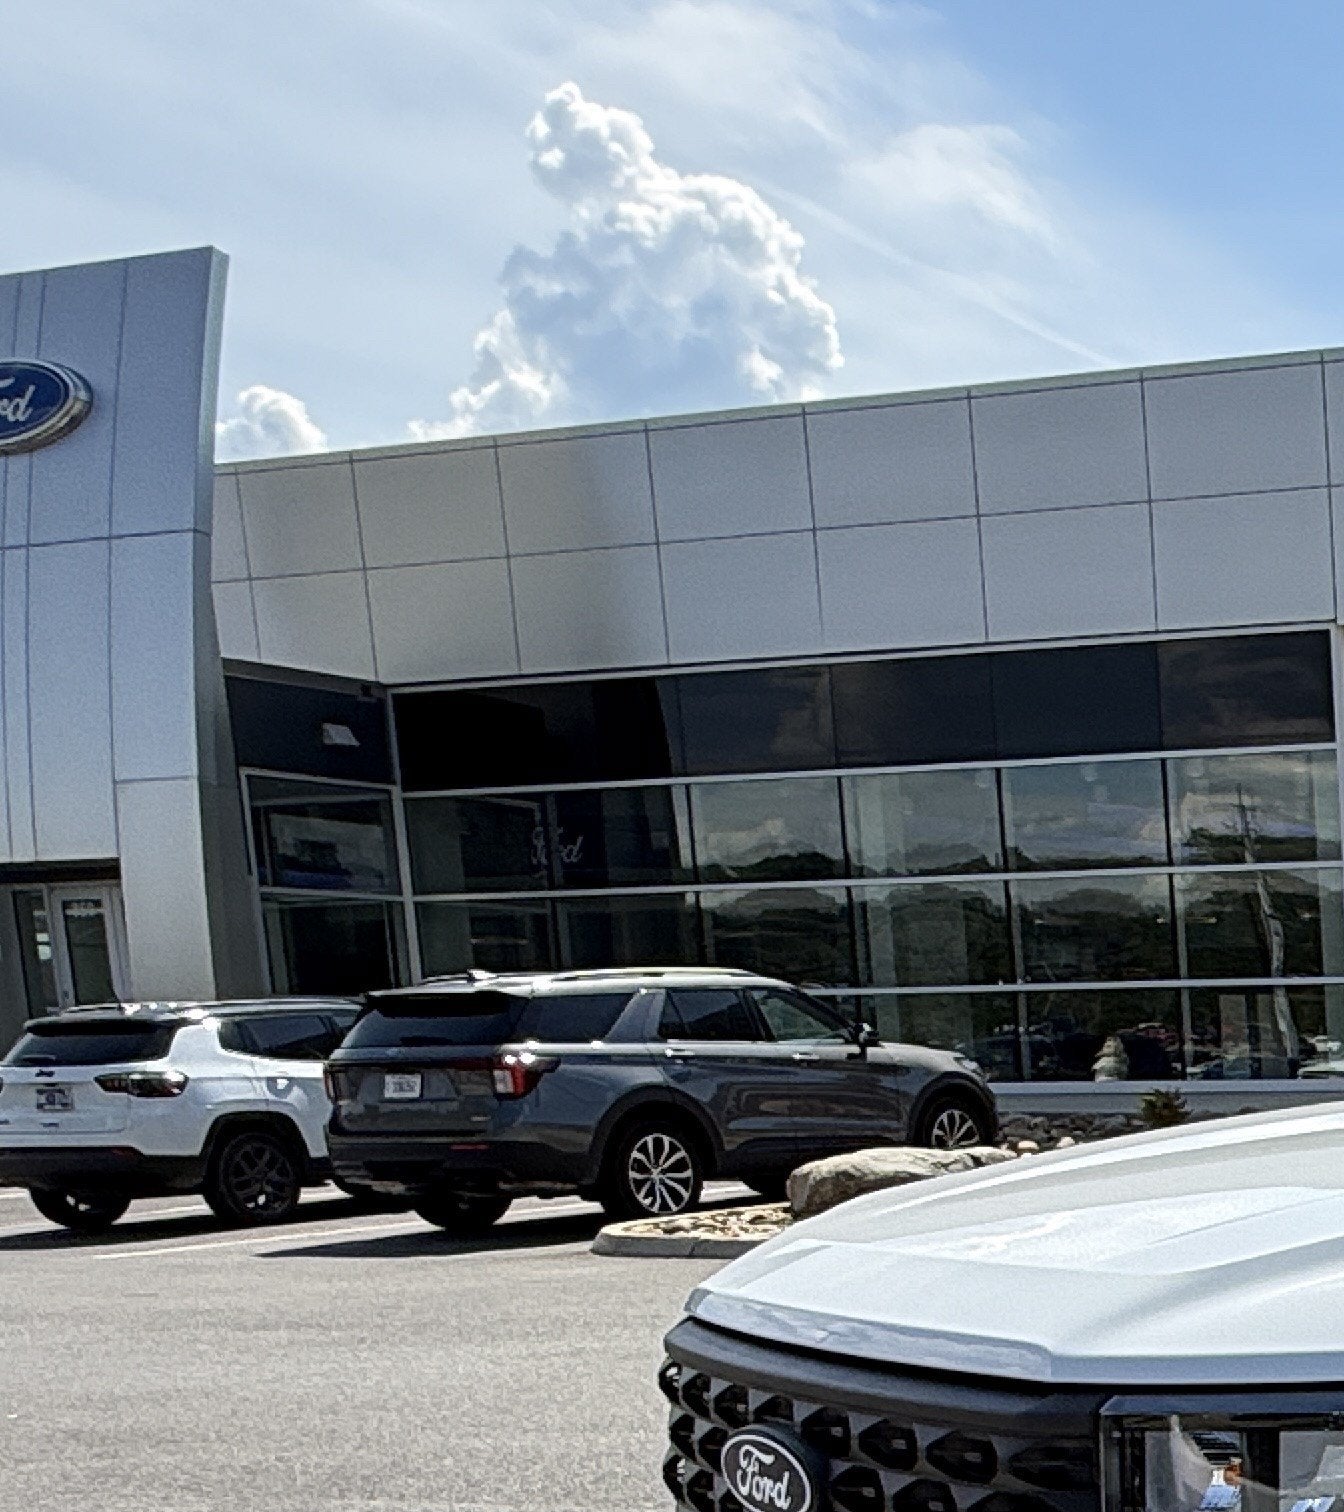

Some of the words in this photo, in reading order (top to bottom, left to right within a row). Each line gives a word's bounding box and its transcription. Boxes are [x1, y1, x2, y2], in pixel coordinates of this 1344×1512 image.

[0, 377, 35, 421] rd
[530, 826, 583, 864] Fd
[736, 1444, 792, 1510] Ford
